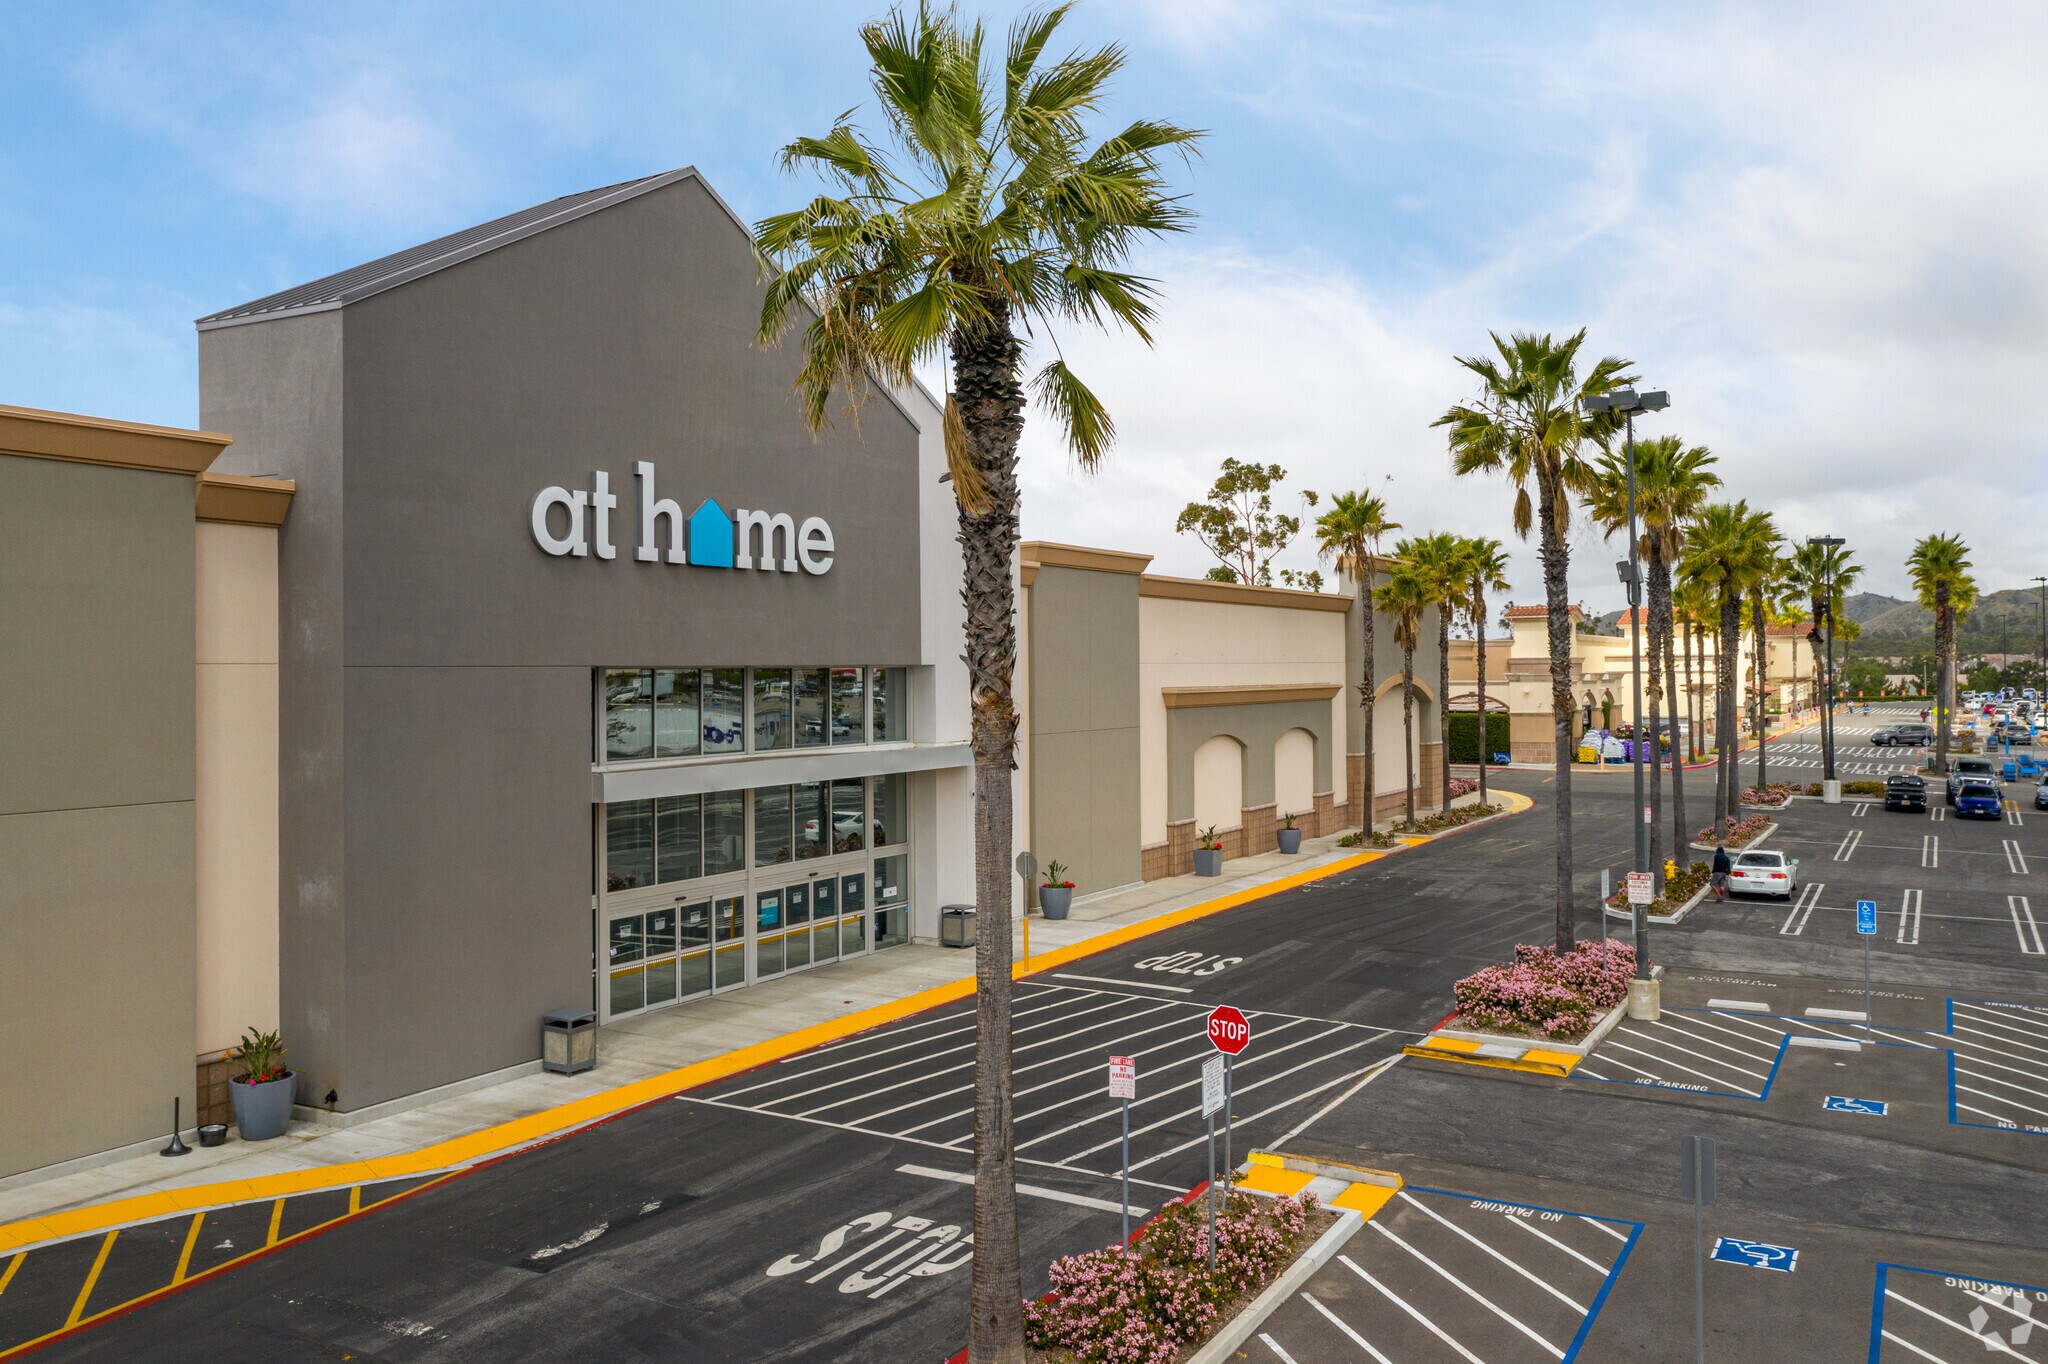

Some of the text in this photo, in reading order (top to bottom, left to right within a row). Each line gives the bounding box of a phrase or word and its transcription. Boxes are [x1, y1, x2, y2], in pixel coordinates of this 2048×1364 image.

[529, 470, 617, 560] at
[1134, 951, 1243, 976] STOP
[1984, 1001, 2029, 1009] PARKING
[1211, 1019, 1247, 1041] STOP
[1110, 1057, 1121, 1065] FIRE
[1111, 1072, 1134, 1080] PARKING
[1634, 1077, 1709, 1092] NO PARKING
[1998, 1121, 2017, 1130] NO
[1470, 1200, 1563, 1223] NO PARKING
[765, 1211, 975, 1300] STOP
[1944, 1276, 2025, 1299] PARKING
